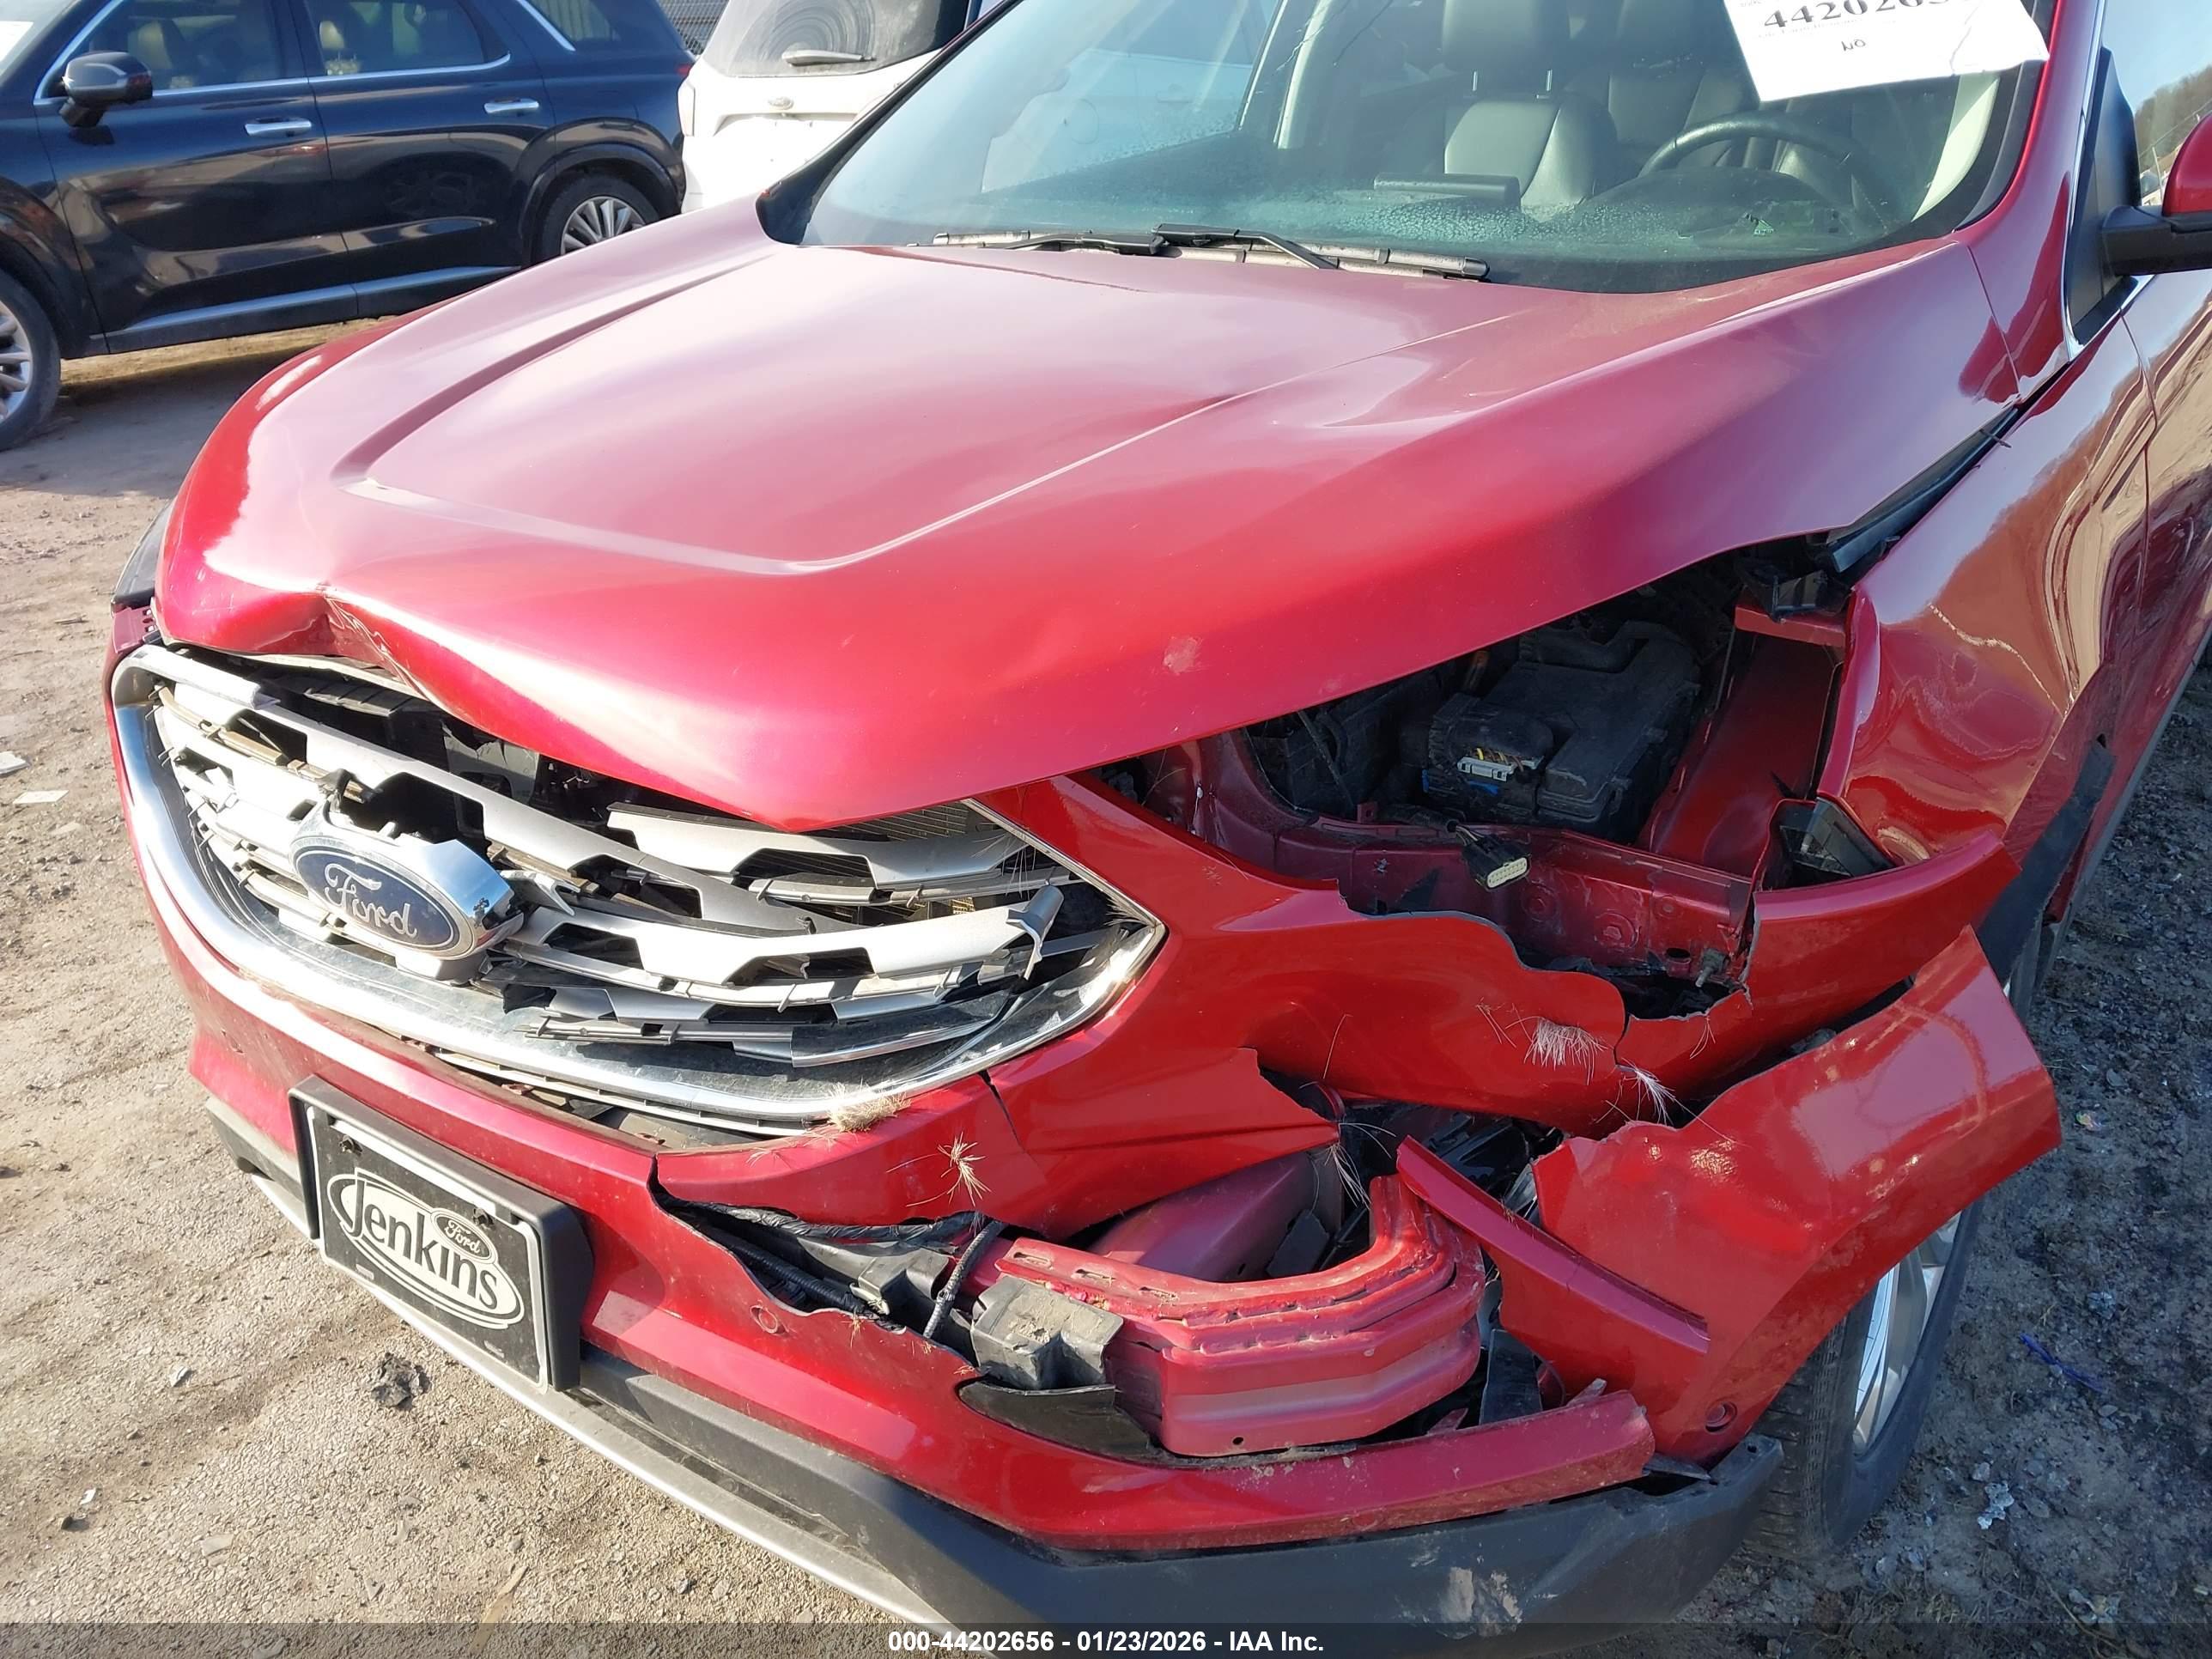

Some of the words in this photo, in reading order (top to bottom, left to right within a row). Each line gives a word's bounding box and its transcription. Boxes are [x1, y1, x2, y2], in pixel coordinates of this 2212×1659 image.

[324, 862, 417, 939] Ford
[328, 1178, 498, 1310] Jenkins
[444, 1219, 481, 1254] Ford
